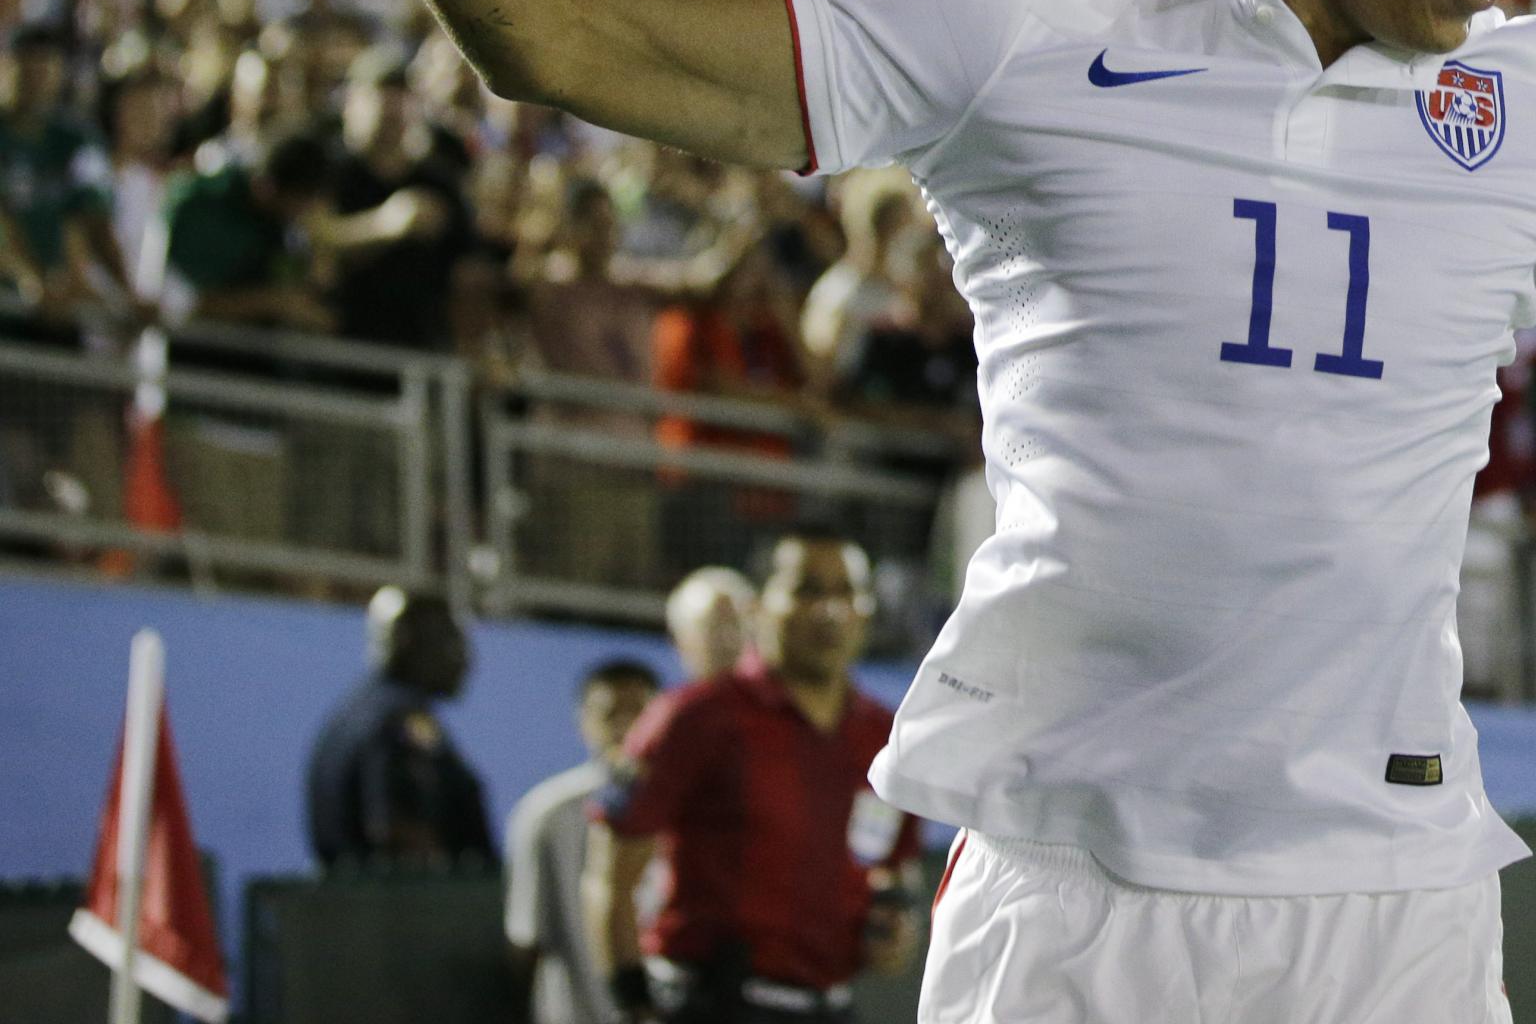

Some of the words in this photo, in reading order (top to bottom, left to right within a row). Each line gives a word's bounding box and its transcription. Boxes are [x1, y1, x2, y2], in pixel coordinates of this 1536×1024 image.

[1428, 89, 1495, 128] US
[1220, 198, 1384, 379] 11
[938, 672, 994, 702] DRI-FIT
